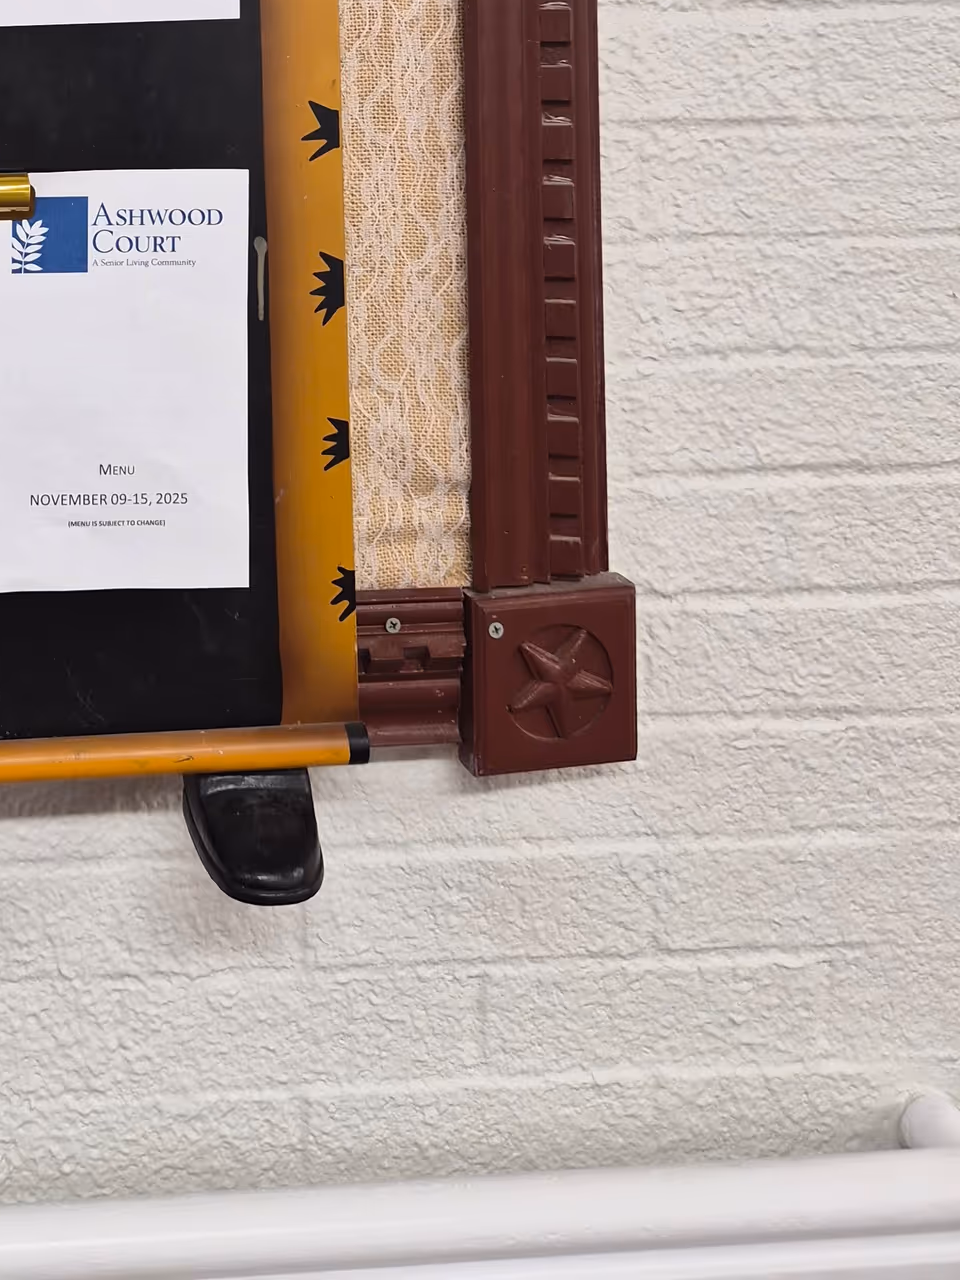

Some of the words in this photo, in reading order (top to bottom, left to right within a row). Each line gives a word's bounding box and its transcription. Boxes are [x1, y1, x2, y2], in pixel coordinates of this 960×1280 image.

[92, 202, 223, 226] ASHWOOD
[93, 229, 181, 253] COURT
[126, 259, 149, 267] Living
[150, 258, 197, 267] Community
[99, 464, 135, 475] MENU
[30, 494, 108, 506] NOVEMBER
[111, 493, 152, 506] 09-15,
[155, 493, 188, 504] 2025
